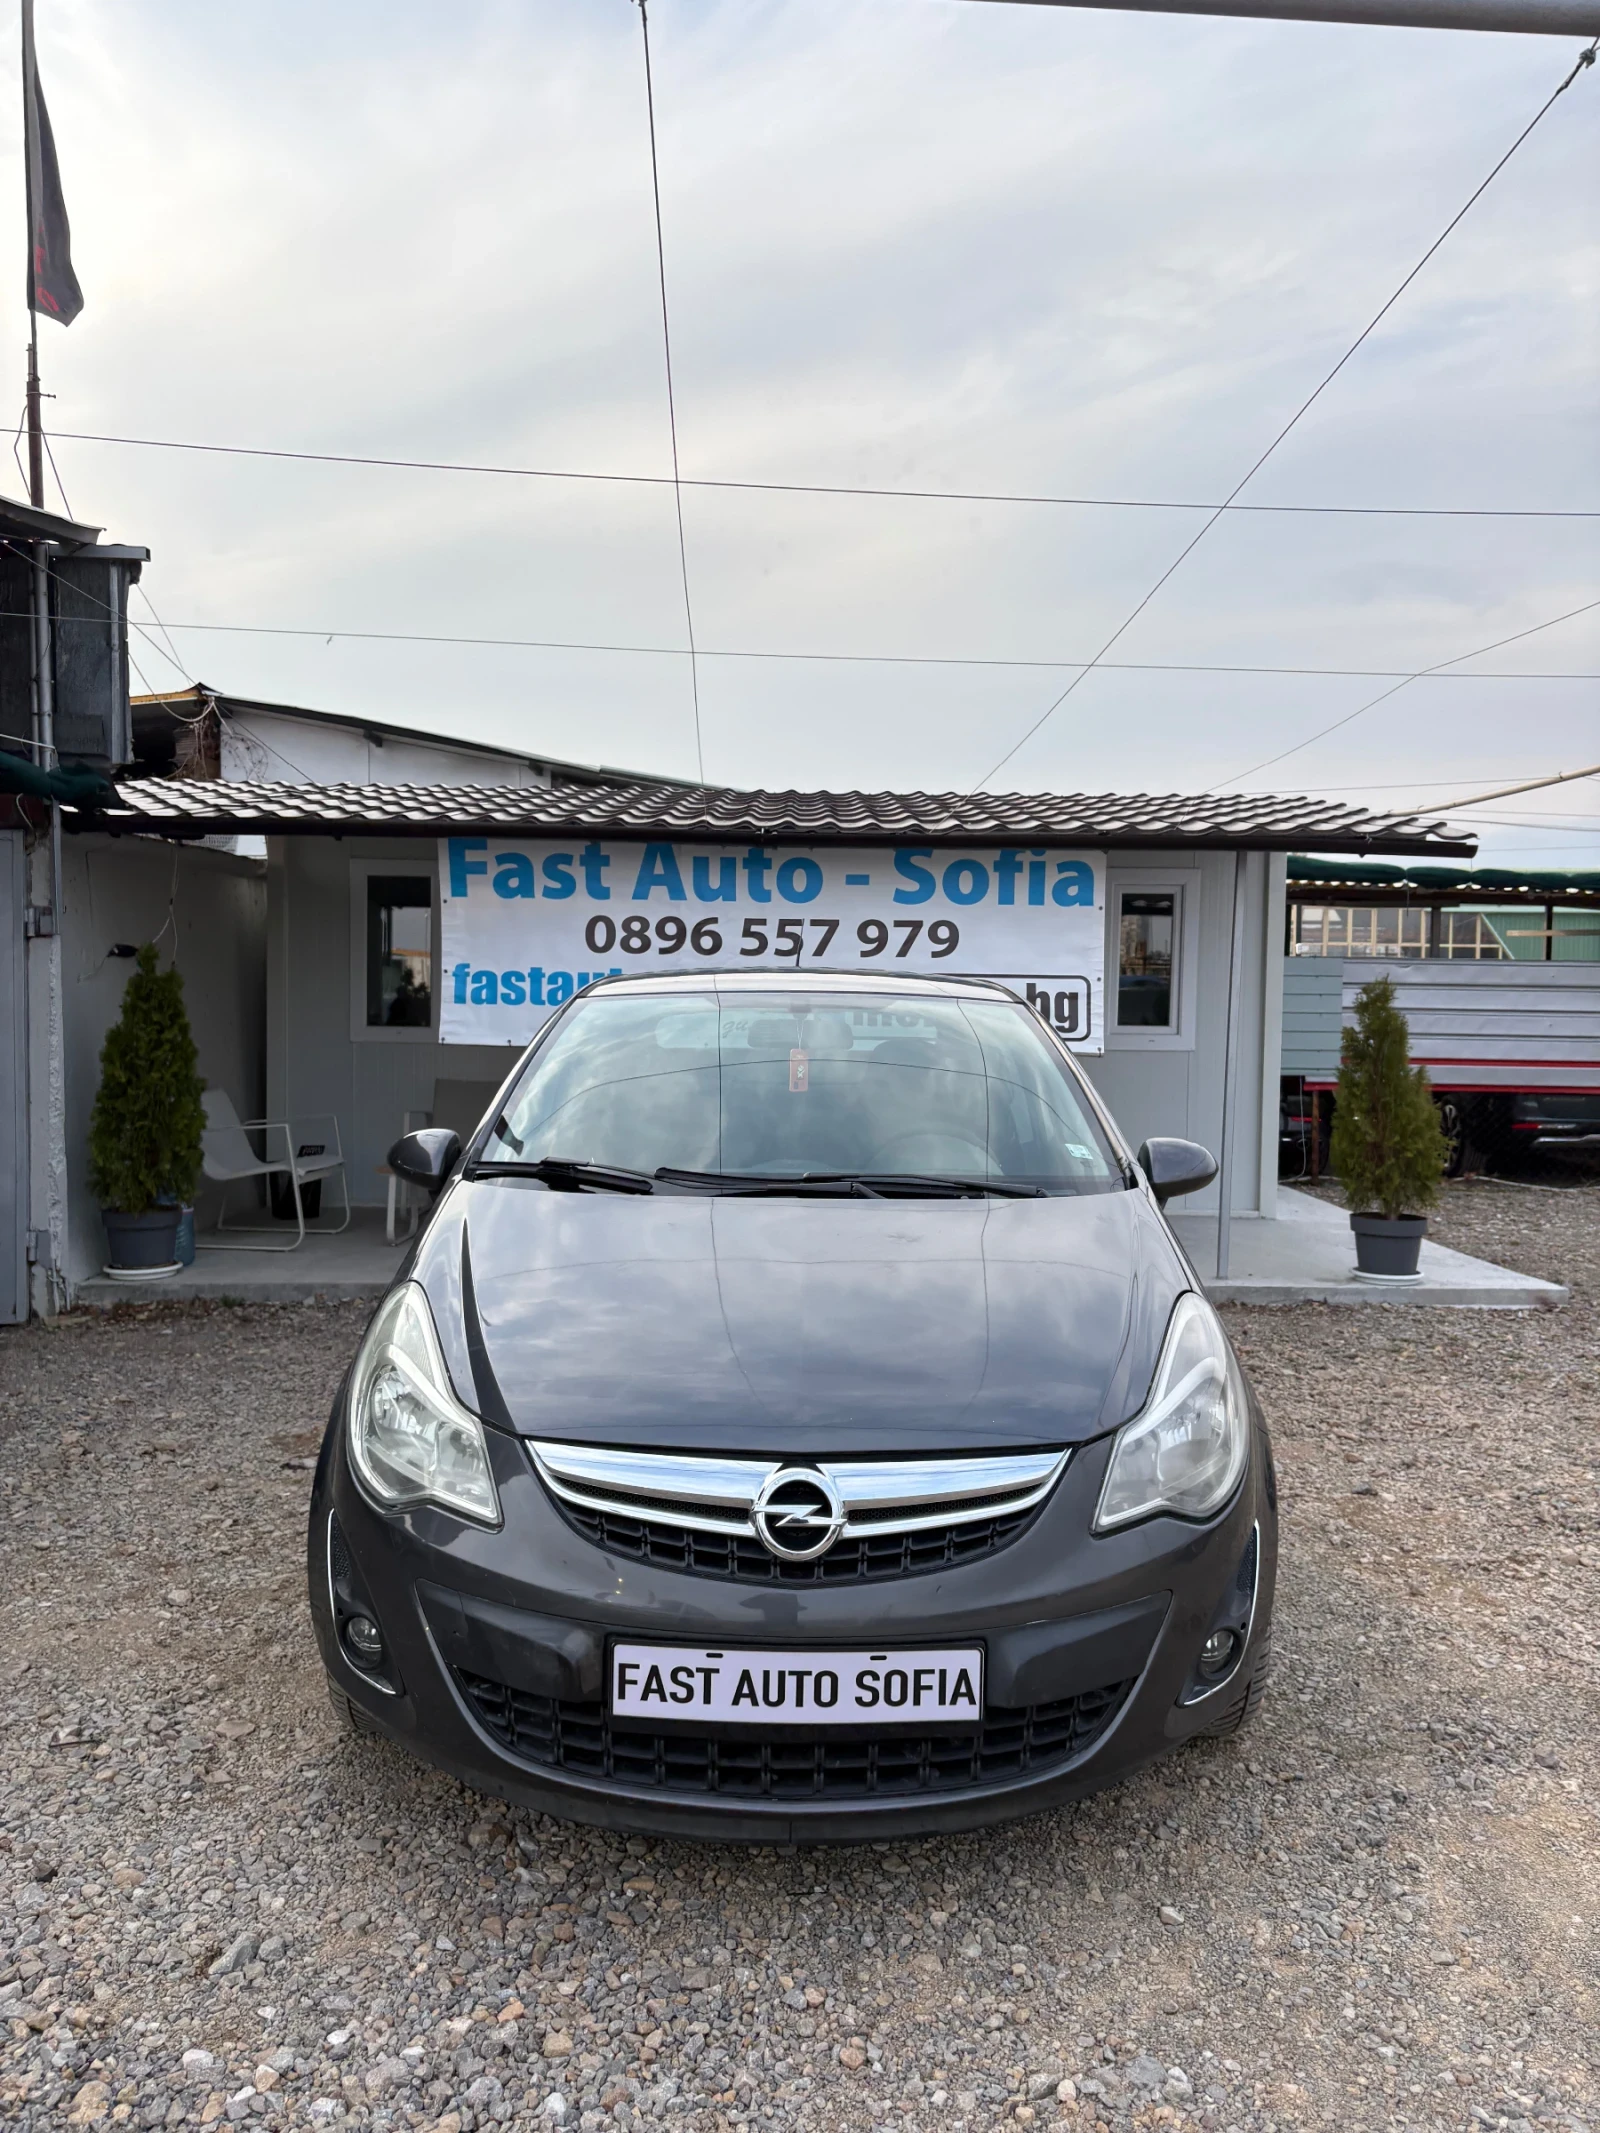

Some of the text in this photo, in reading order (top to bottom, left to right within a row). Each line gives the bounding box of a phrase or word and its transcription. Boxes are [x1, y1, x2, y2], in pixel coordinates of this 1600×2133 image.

[447, 837, 611, 901] Fast
[631, 841, 824, 904] Auto
[891, 847, 1095, 908] Sofia
[584, 914, 960, 959] 0896 557 979
[617, 1662, 977, 1708] FAST AUTO SOFIA
